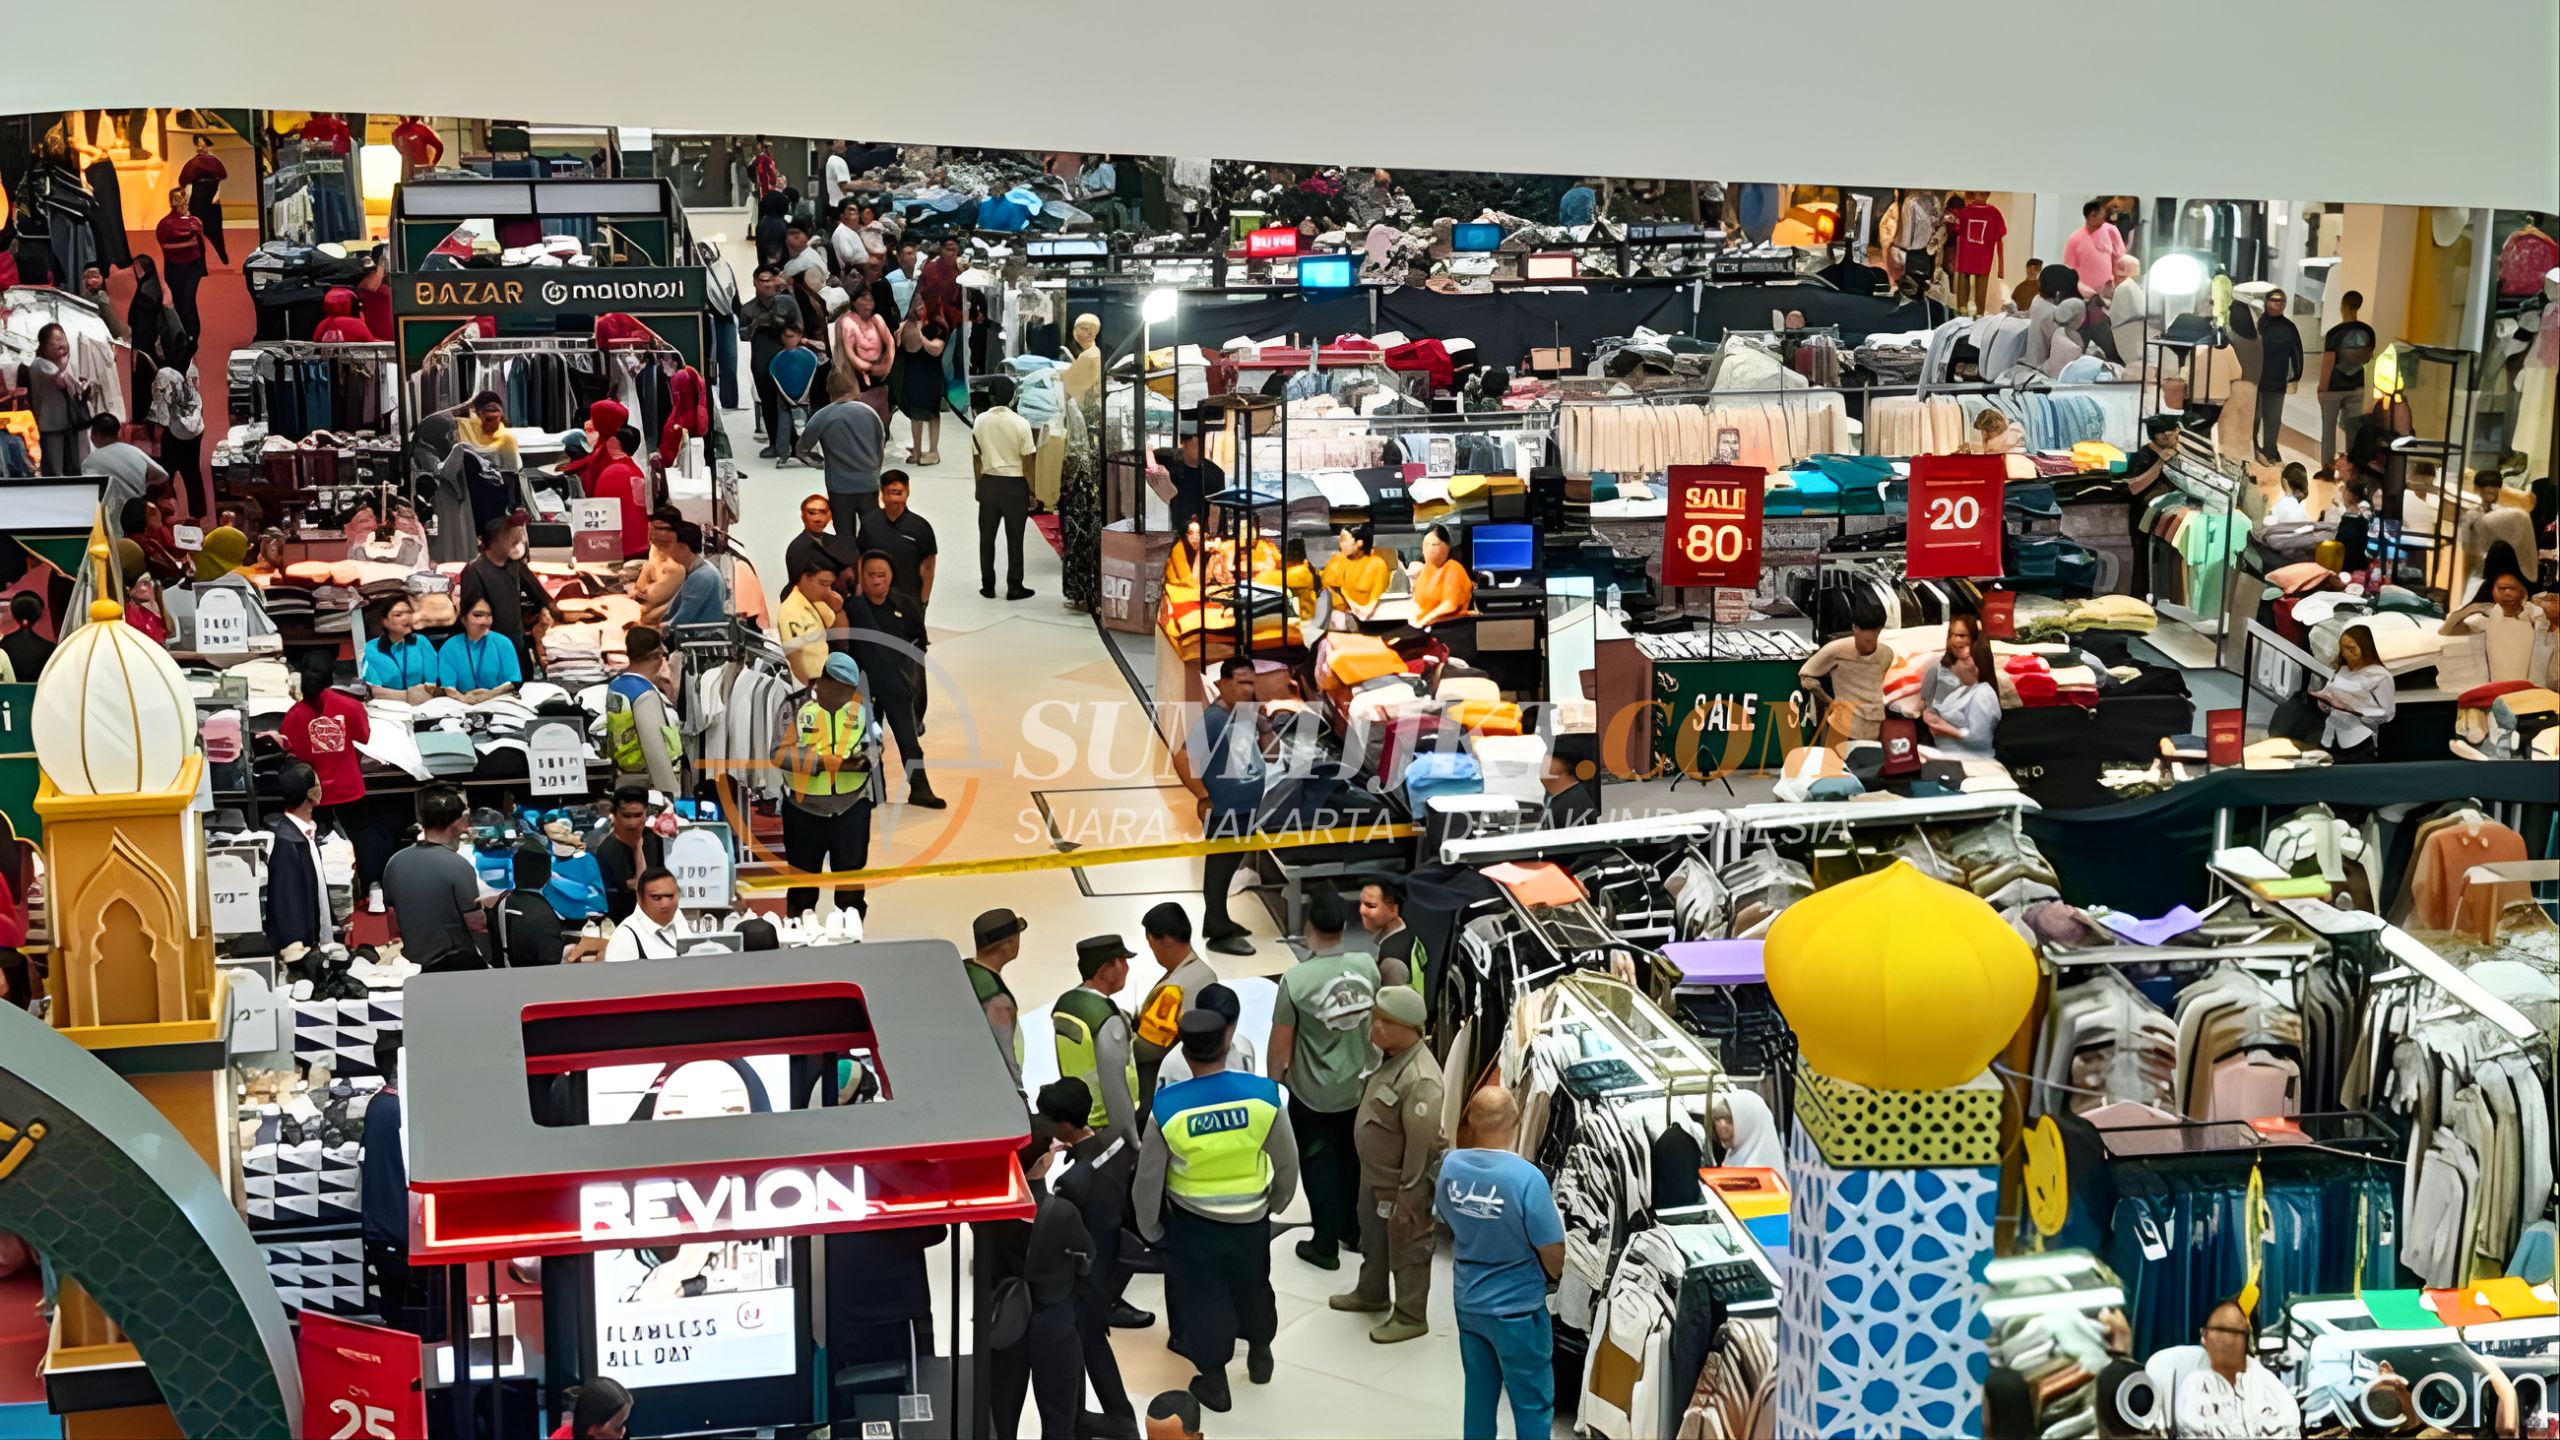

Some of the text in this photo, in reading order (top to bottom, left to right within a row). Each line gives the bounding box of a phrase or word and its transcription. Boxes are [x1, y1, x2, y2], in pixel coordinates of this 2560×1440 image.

[415, 281, 525, 305] BAZAR
[1929, 496, 1980, 530] 20
[1686, 524, 1743, 562] 80
[1692, 692, 1758, 731] SALE
[580, 1165, 867, 1242] REVLON
[329, 1399, 396, 1440] 25
